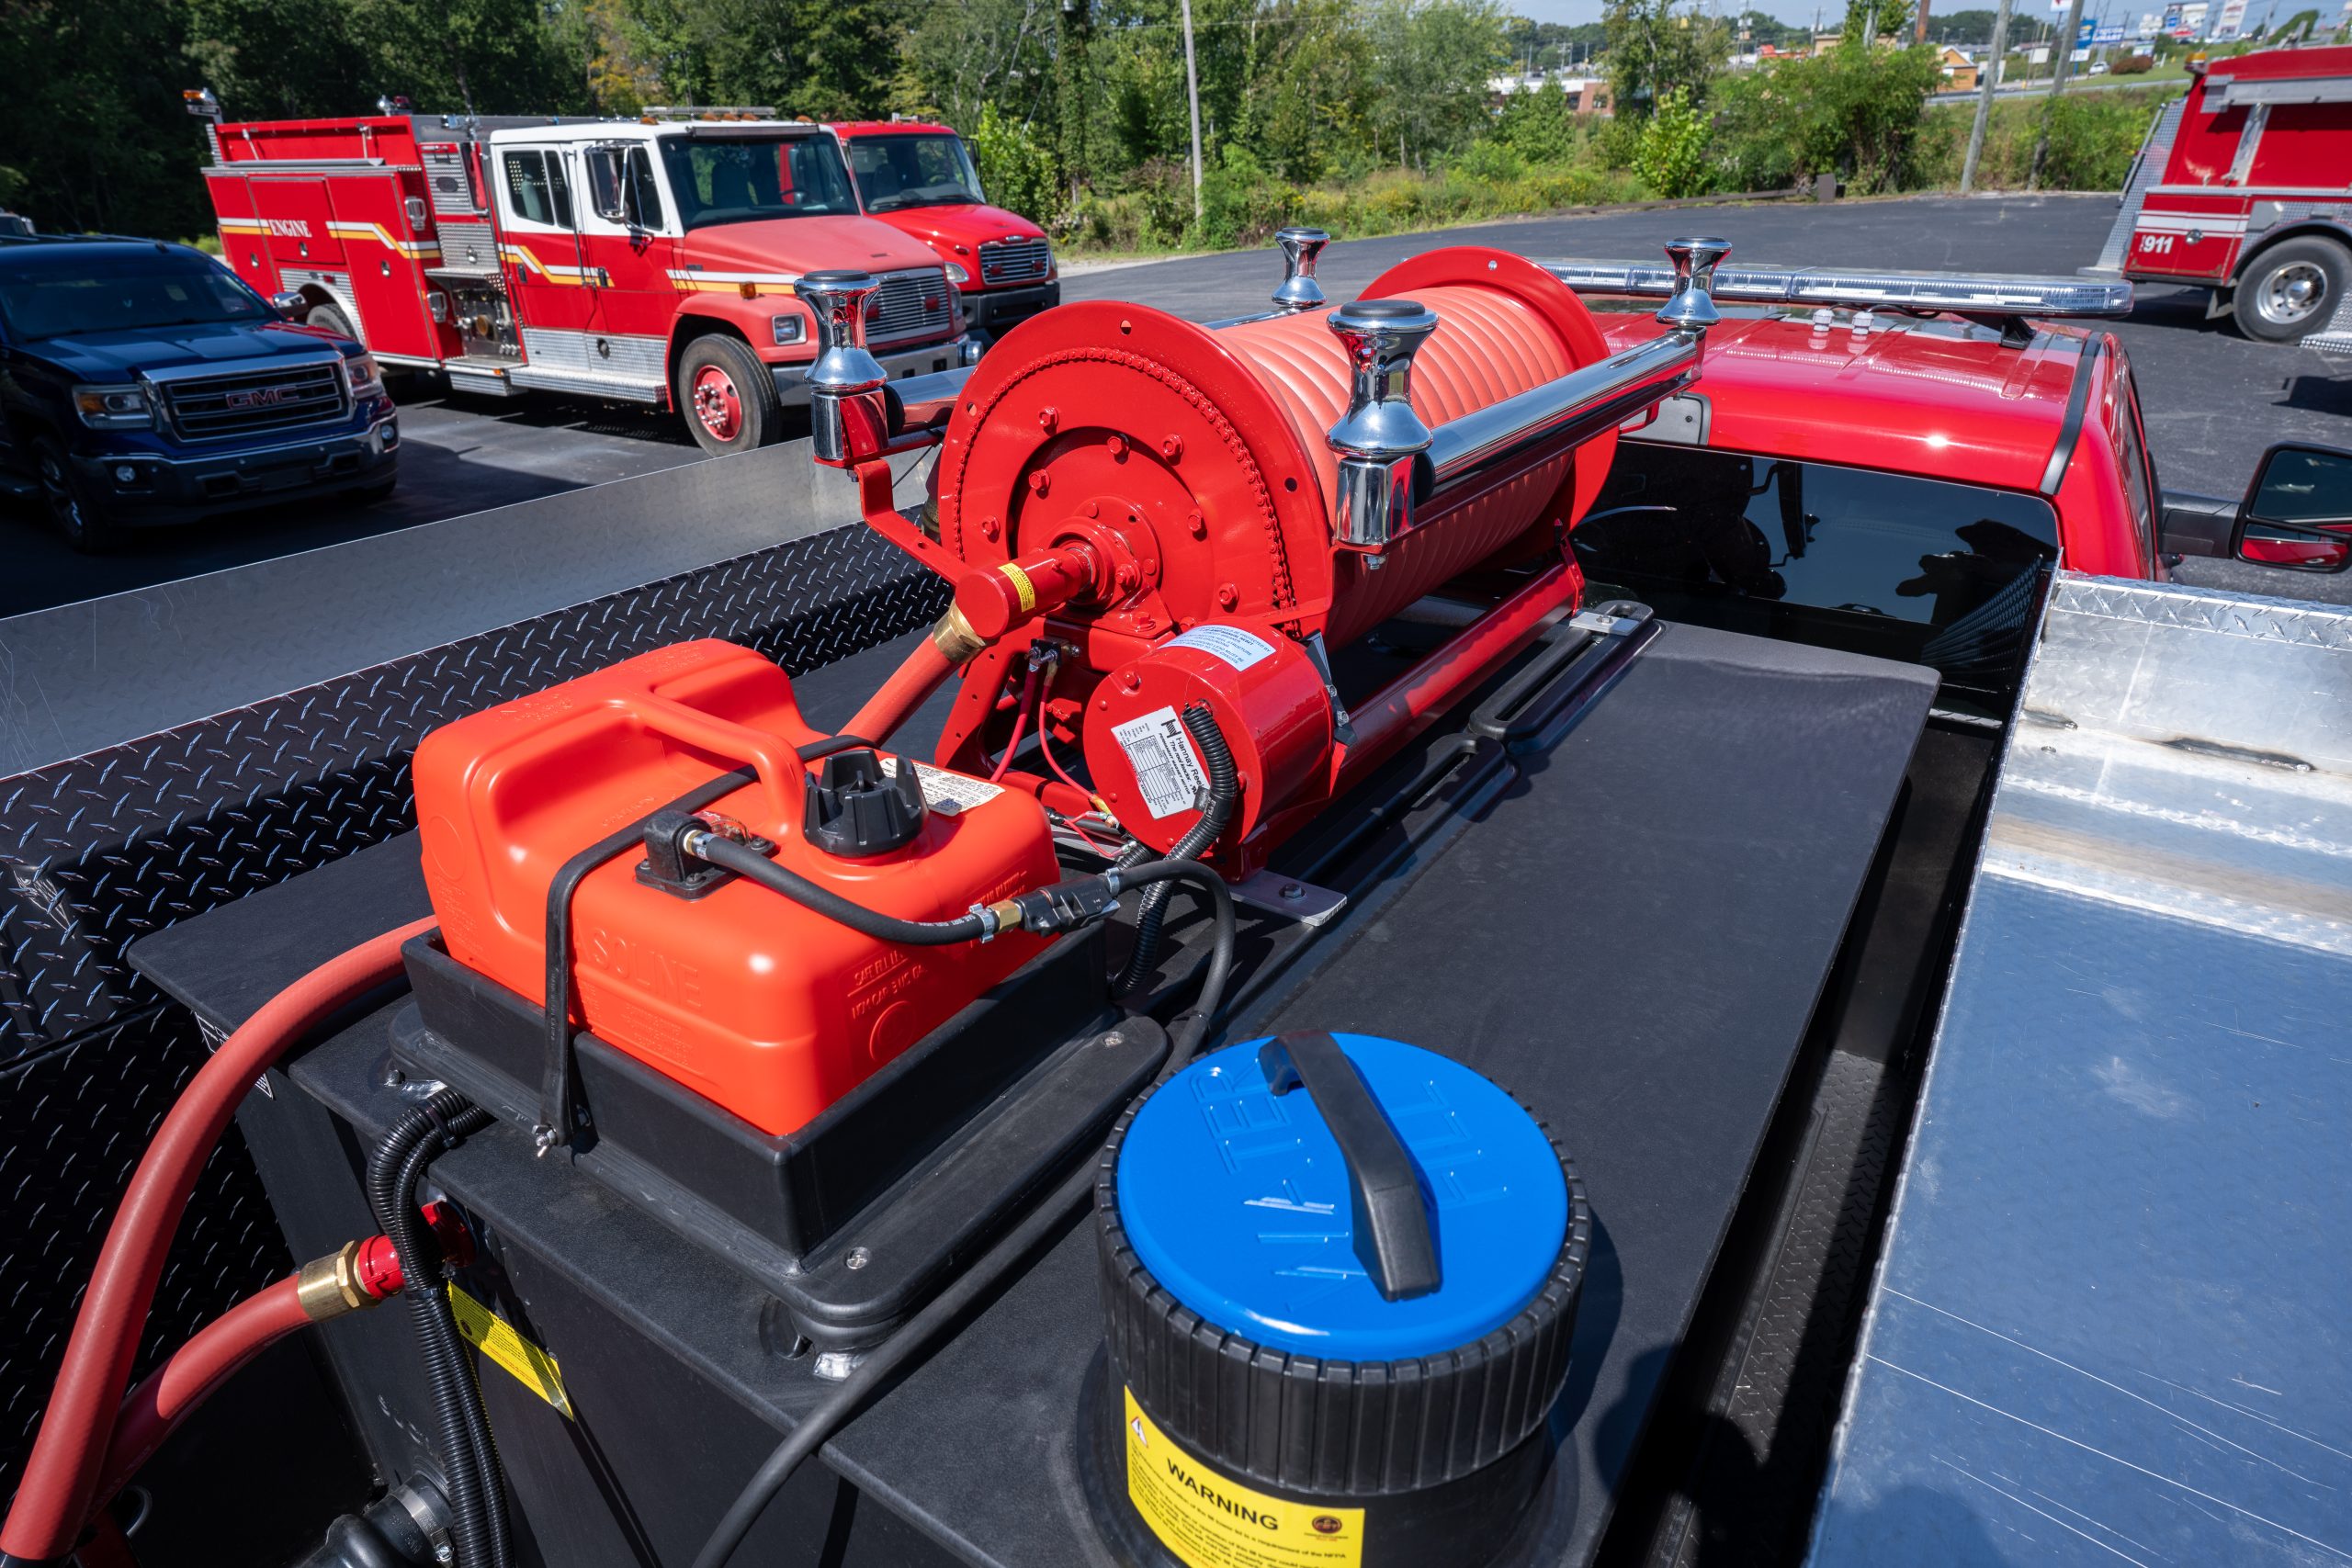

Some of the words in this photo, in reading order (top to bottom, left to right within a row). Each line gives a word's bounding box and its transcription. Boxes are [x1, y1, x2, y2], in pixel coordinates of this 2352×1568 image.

[267, 219, 313, 238] ENGINE
[2143, 234, 2174, 254] 911
[225, 386, 300, 411] GMC
[1017, 570, 1034, 595] CAUTION
[1176, 737, 1194, 768] Hannay
[575, 919, 703, 1011] ASOLINE
[1189, 1055, 1367, 1313] WATER
[1166, 1457, 1280, 1532] WARNING
